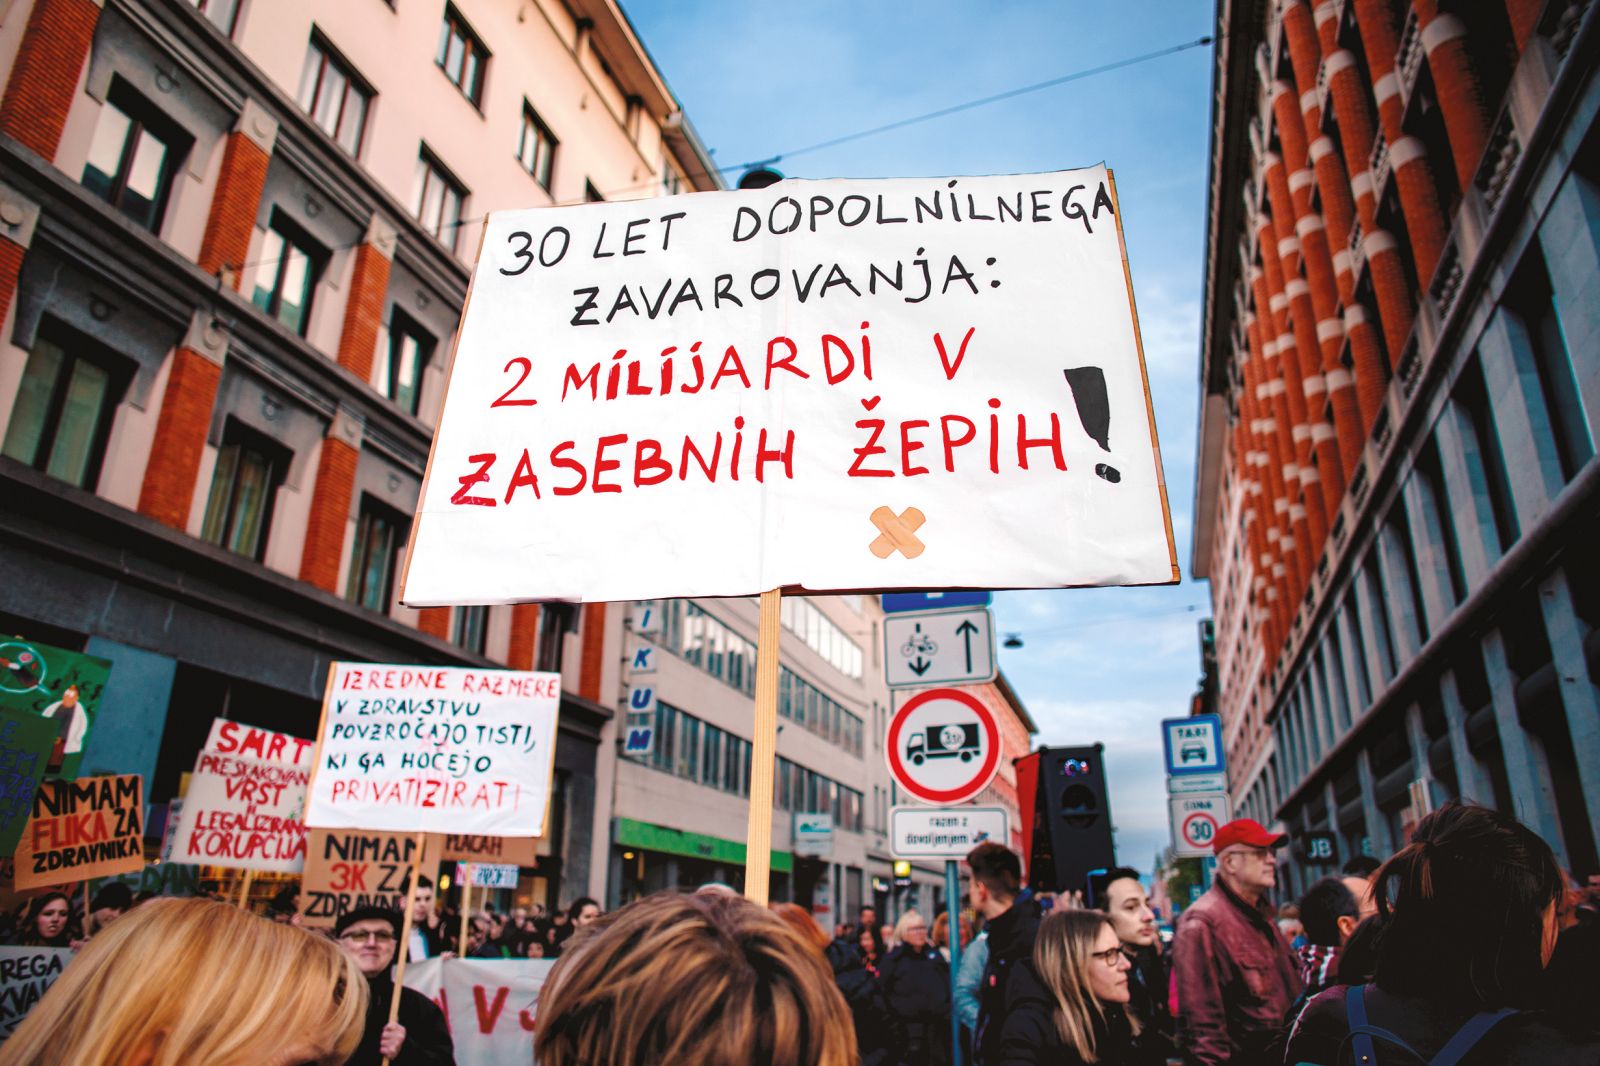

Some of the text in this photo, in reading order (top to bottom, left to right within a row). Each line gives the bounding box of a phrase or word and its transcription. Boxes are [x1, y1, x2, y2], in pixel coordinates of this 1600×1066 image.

[499, 180, 1114, 276] 30 LET DOPOLNILNEGA
[570, 247, 1001, 326] ZAVAROVANJA:
[490, 321, 975, 408] 2 MILIJARDI V
[450, 416, 795, 507] ZASEBNIH
[341, 670, 559, 698] IZREDNE RAZMERE
[336, 699, 481, 717] V ZDRAVSTVU
[216, 721, 311, 764] SMRT
[332, 718, 537, 753] POVZROČAJO TISTI,
[327, 753, 346, 770] KI
[358, 753, 385, 774] GA
[33, 775, 140, 819] NIMAM
[226, 779, 288, 806] VRST
[331, 777, 521, 812] PRIVATIZIRATI
[32, 812, 109, 850] FLIKA
[113, 807, 141, 838] ZA
[1189, 821, 1213, 841] 30
[32, 838, 141, 874] ZDRAVNIKA
[329, 863, 369, 892] 3K
